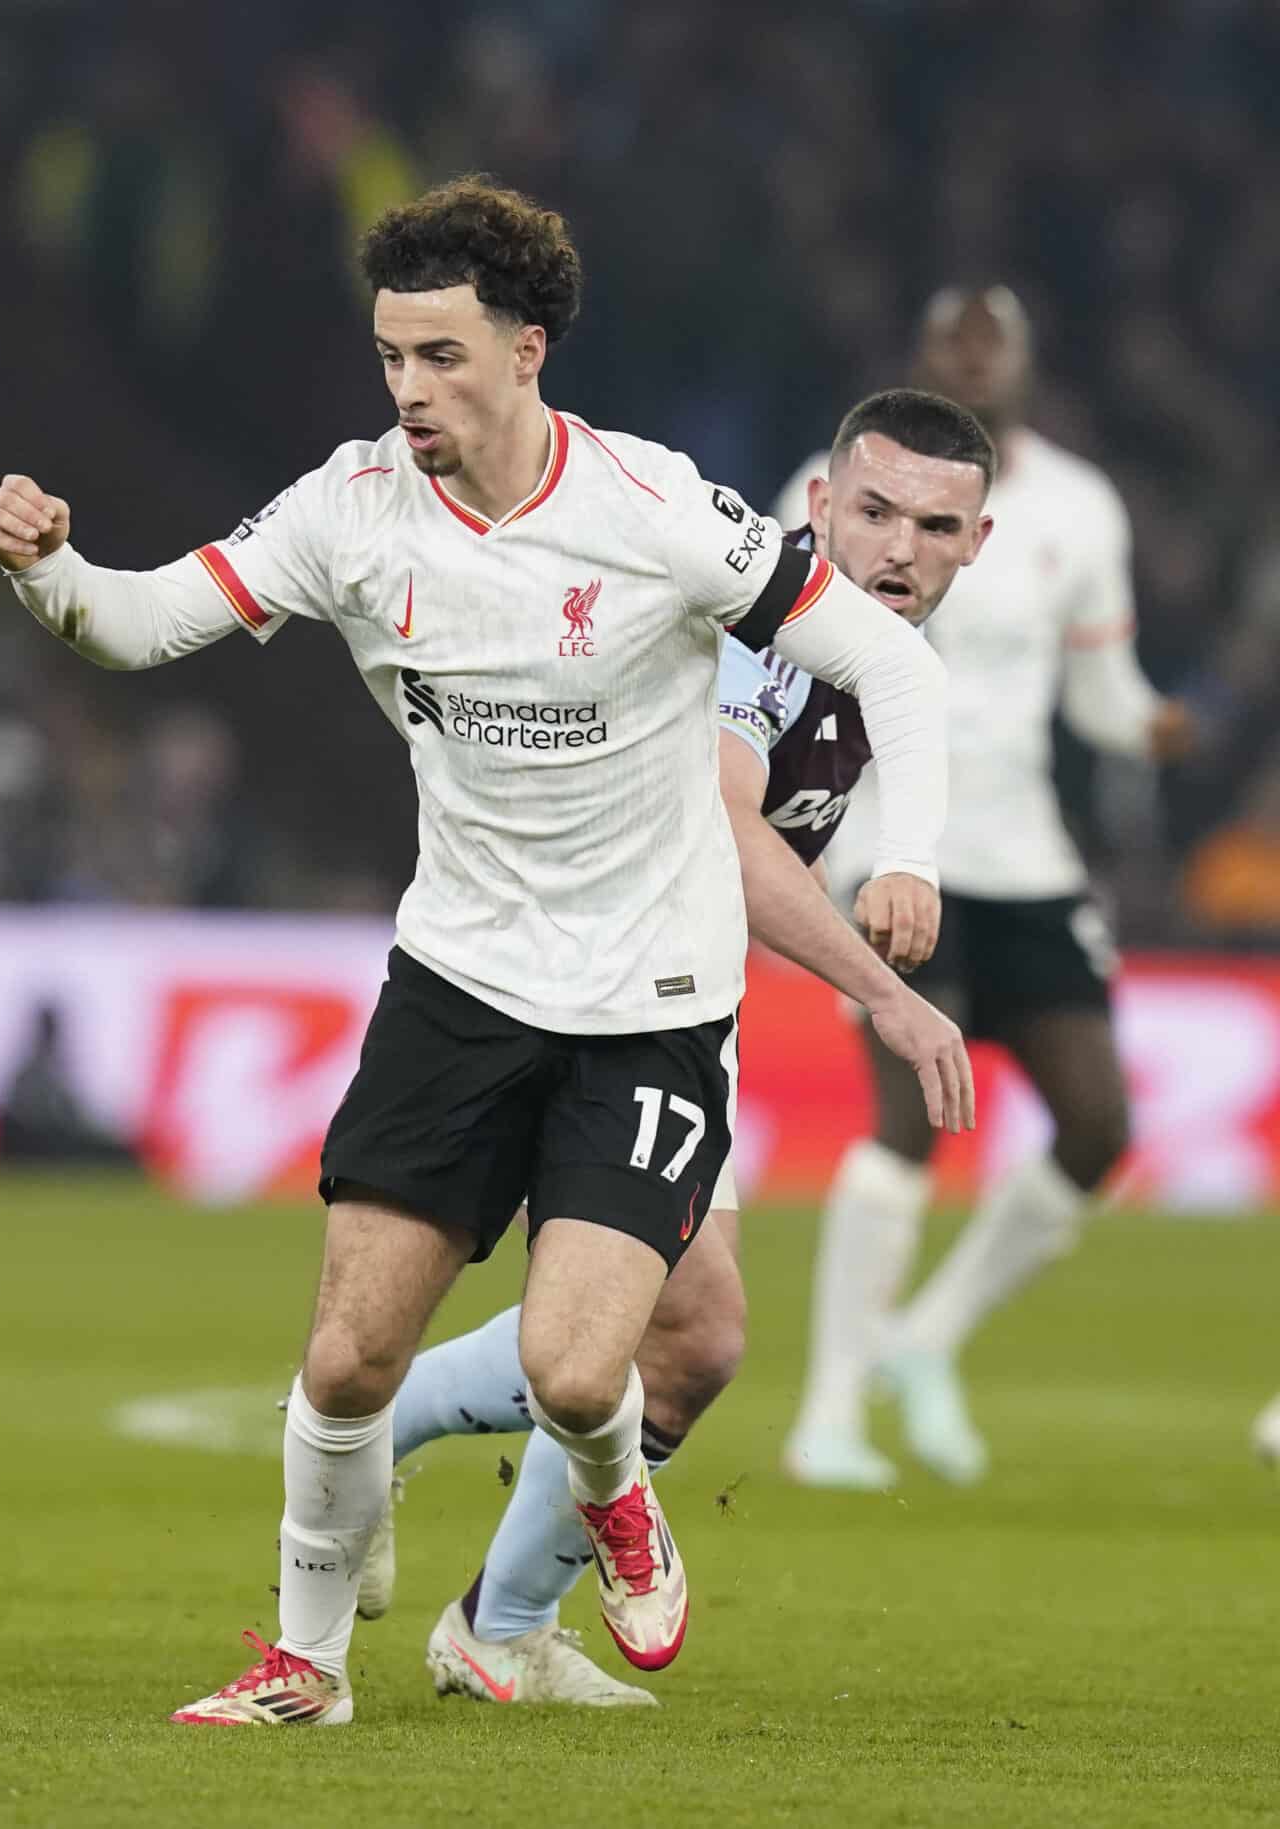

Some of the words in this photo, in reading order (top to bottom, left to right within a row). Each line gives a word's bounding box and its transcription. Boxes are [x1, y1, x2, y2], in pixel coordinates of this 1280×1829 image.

[725, 517, 766, 574] Expe
[447, 693, 597, 724] standard
[453, 716, 608, 749] chartered
[630, 1086, 706, 1183] 17
[295, 1558, 337, 1571] LFC
